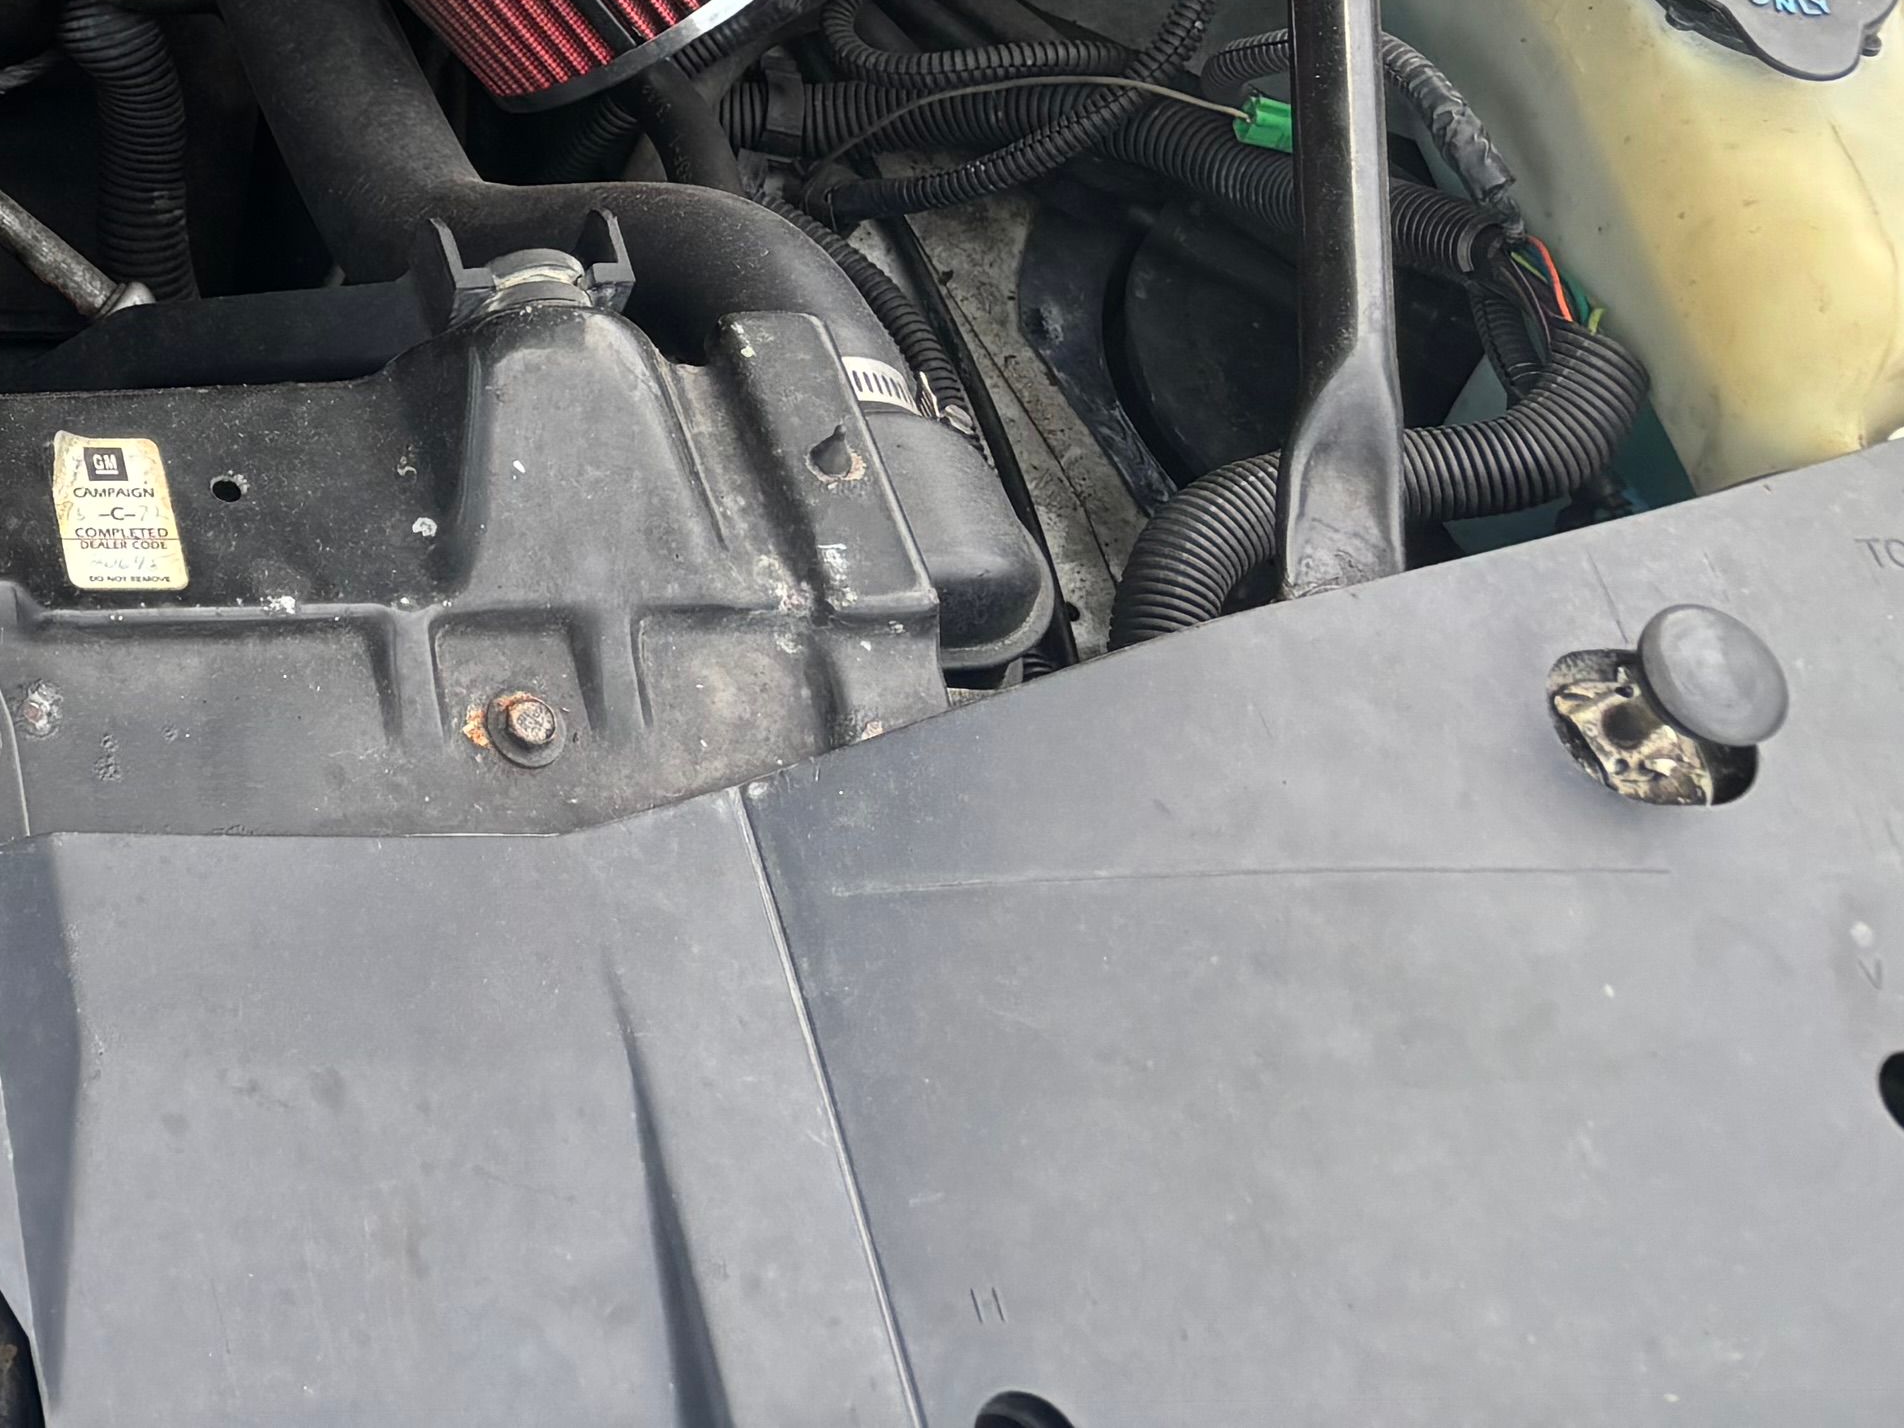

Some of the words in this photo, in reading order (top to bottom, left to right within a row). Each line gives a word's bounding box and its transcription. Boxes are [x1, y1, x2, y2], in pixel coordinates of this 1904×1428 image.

[92, 453, 118, 470] GM
[73, 487, 155, 498] CAMPAIGN
[74, 527, 169, 538] COMPLETED
[80, 540, 128, 550] DEALER
[132, 540, 168, 550] CODE
